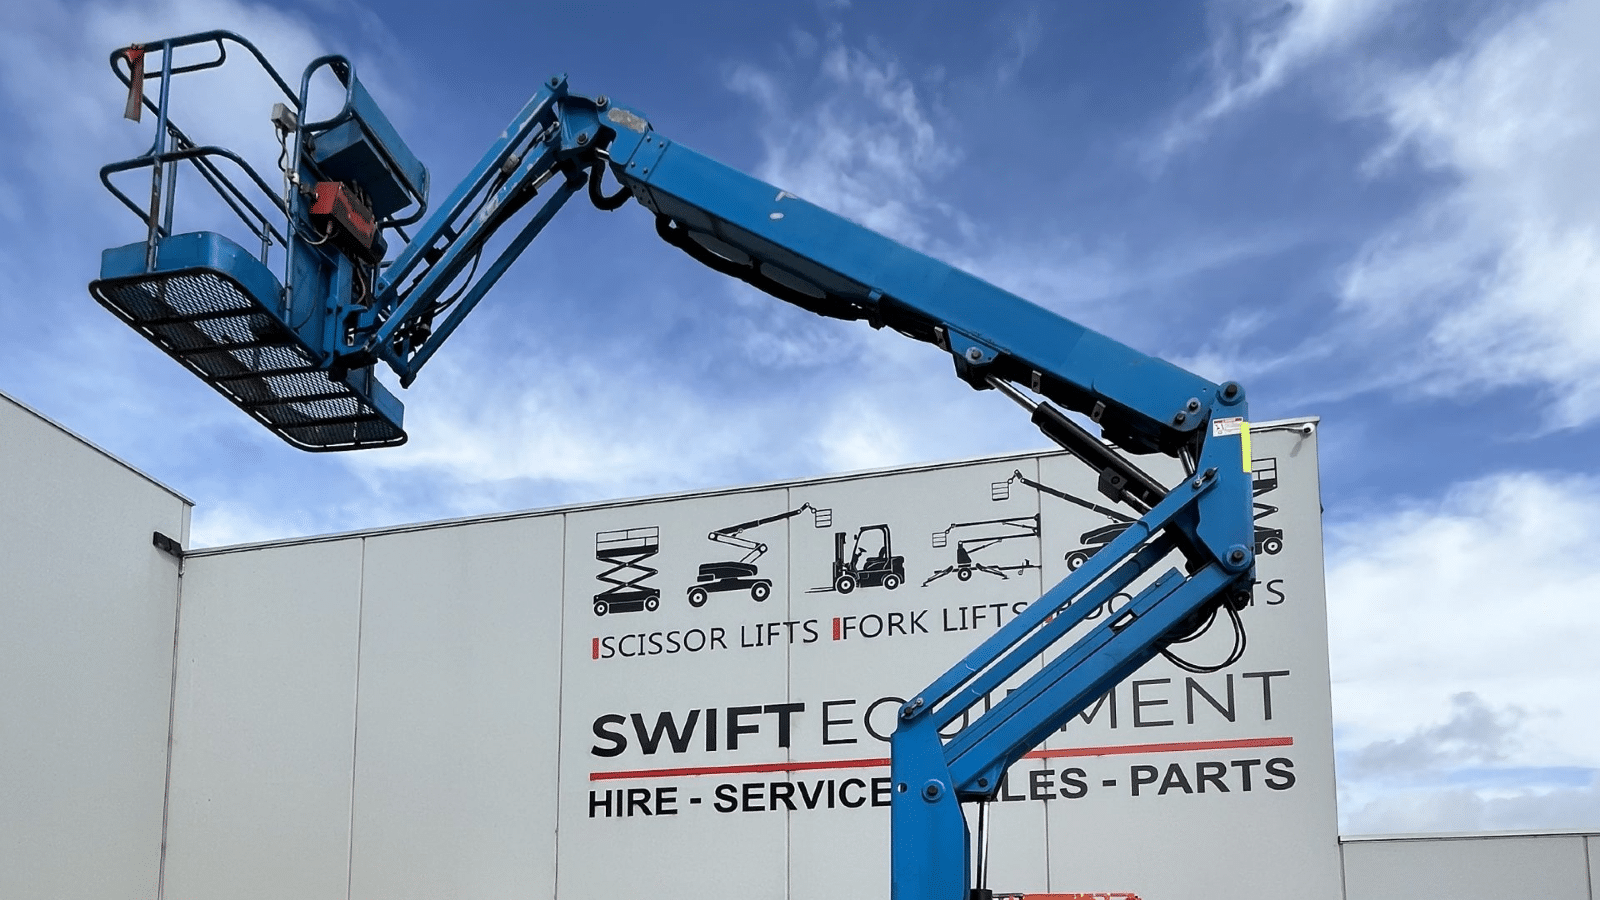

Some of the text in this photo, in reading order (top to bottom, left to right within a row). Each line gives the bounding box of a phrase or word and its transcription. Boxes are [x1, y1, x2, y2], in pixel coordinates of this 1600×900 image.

[601, 627, 728, 659] SCISSOR
[741, 619, 819, 648] LIFTS
[842, 609, 929, 640] FORK
[590, 670, 1290, 758] SWIFT EQMENT
[588, 757, 1296, 818] HIRE - SERVICE LES - PARTS
